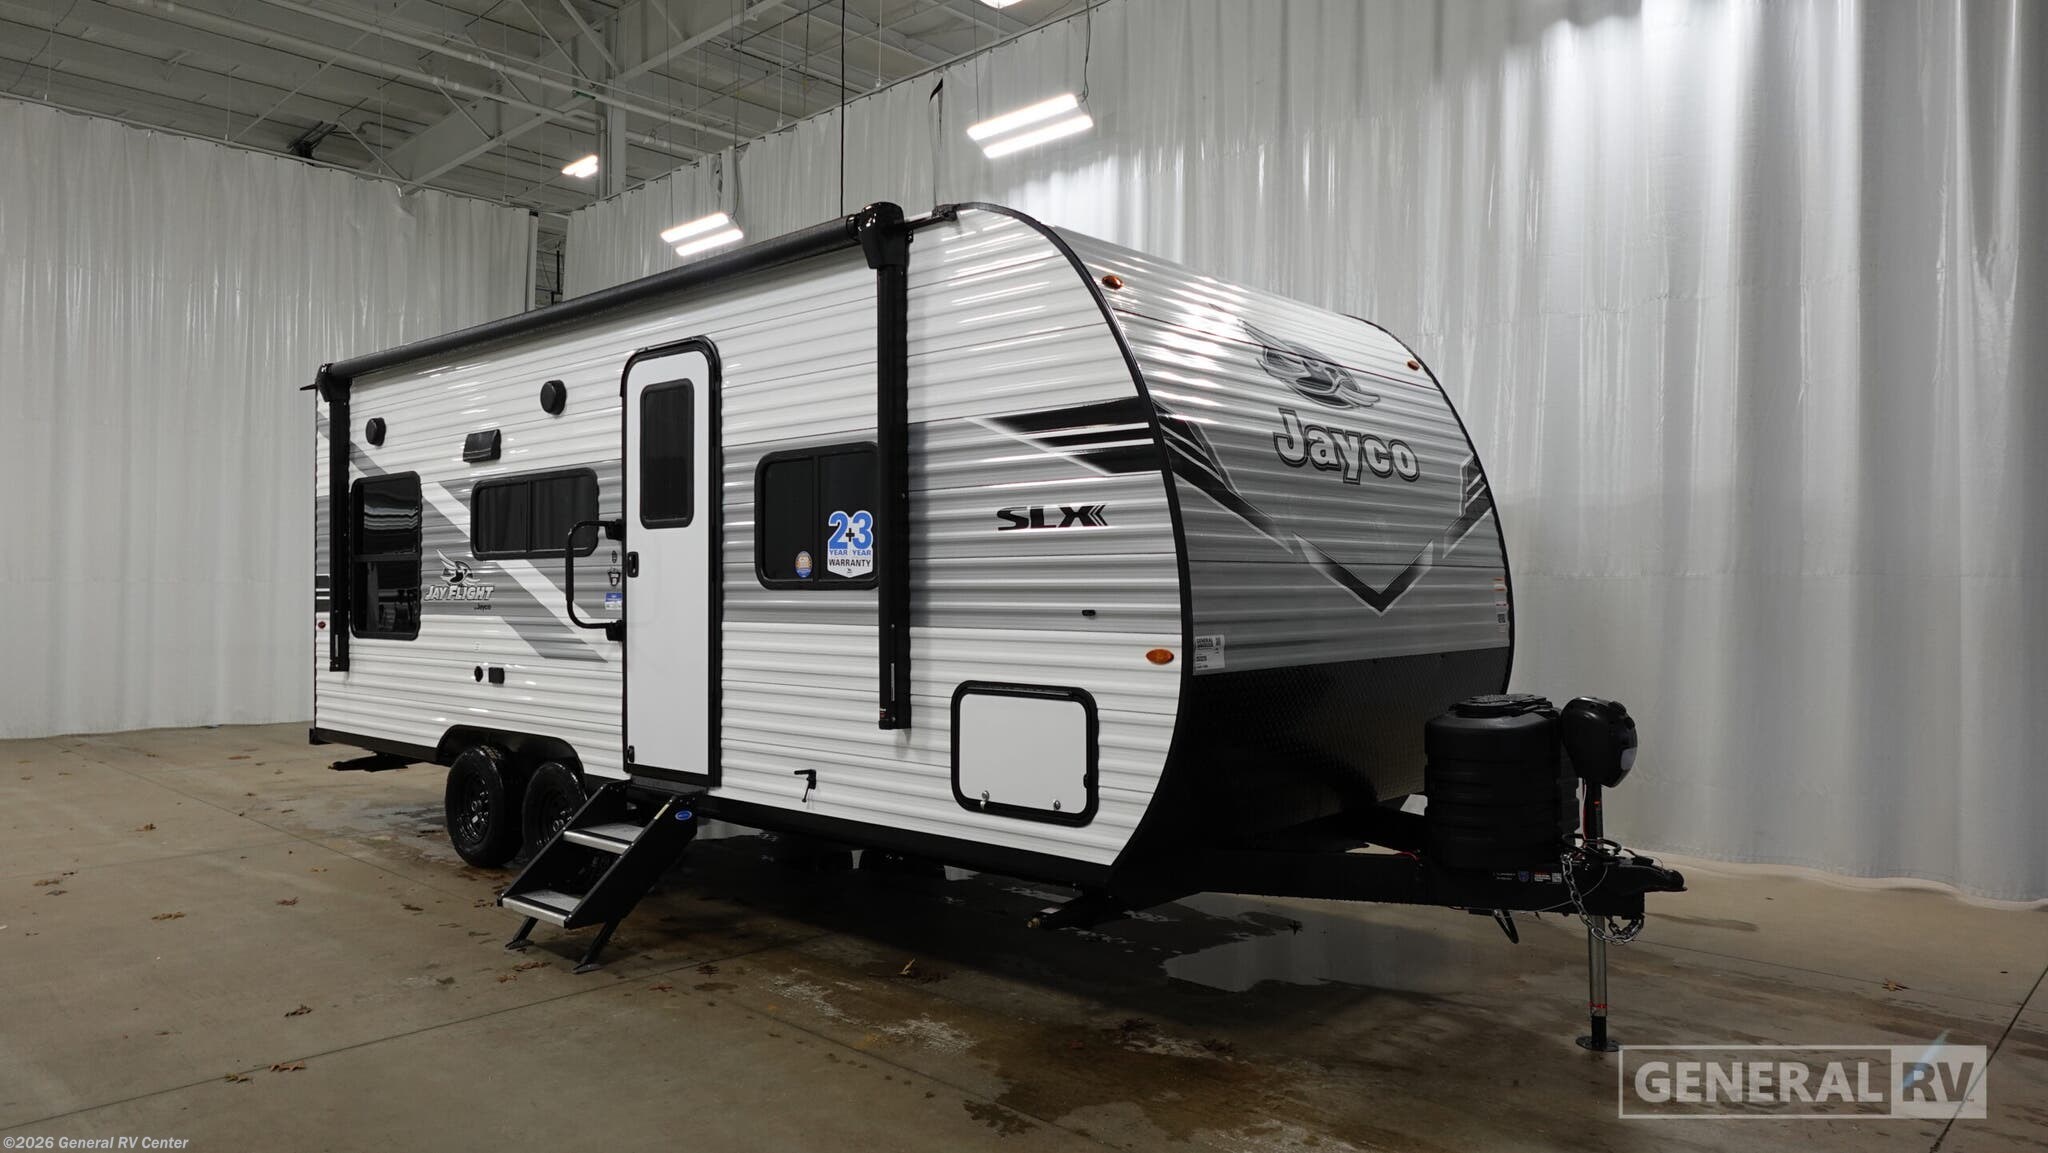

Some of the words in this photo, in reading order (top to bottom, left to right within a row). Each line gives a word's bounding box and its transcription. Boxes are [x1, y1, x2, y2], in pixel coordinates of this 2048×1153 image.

[1273, 408, 1420, 485] Jayco
[997, 505, 1102, 531] SLX
[829, 559, 871, 567] WARRANTY
[424, 585, 448, 601] JAY
[447, 585, 494, 601] FLIGHT
